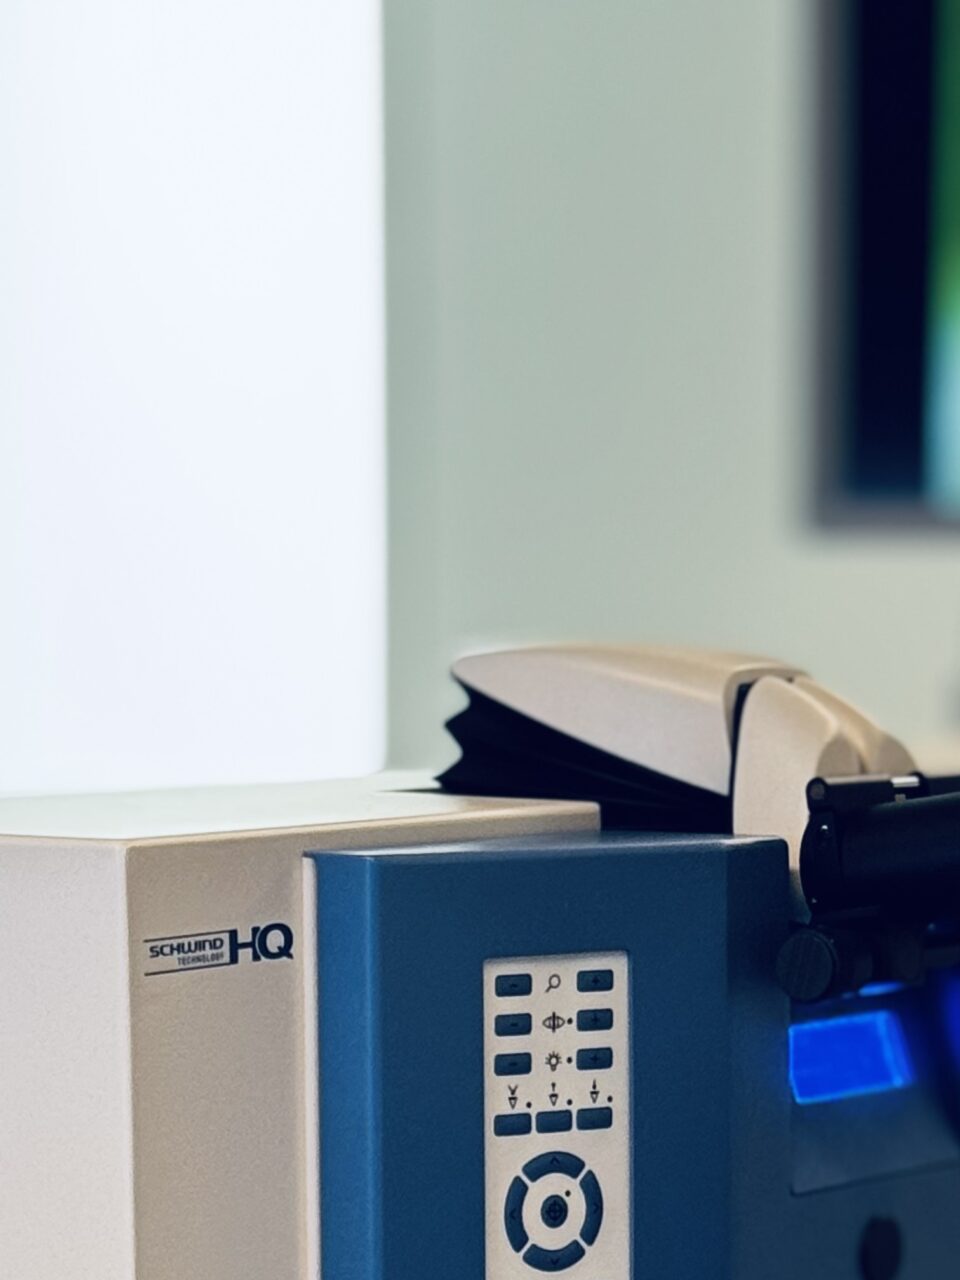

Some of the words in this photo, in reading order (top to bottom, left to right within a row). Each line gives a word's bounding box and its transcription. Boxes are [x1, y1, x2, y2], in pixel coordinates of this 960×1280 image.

[149, 937, 224, 958] SCHWIND
[229, 922, 294, 964] HQ
[177, 951, 224, 966] TECHNOLOGY
